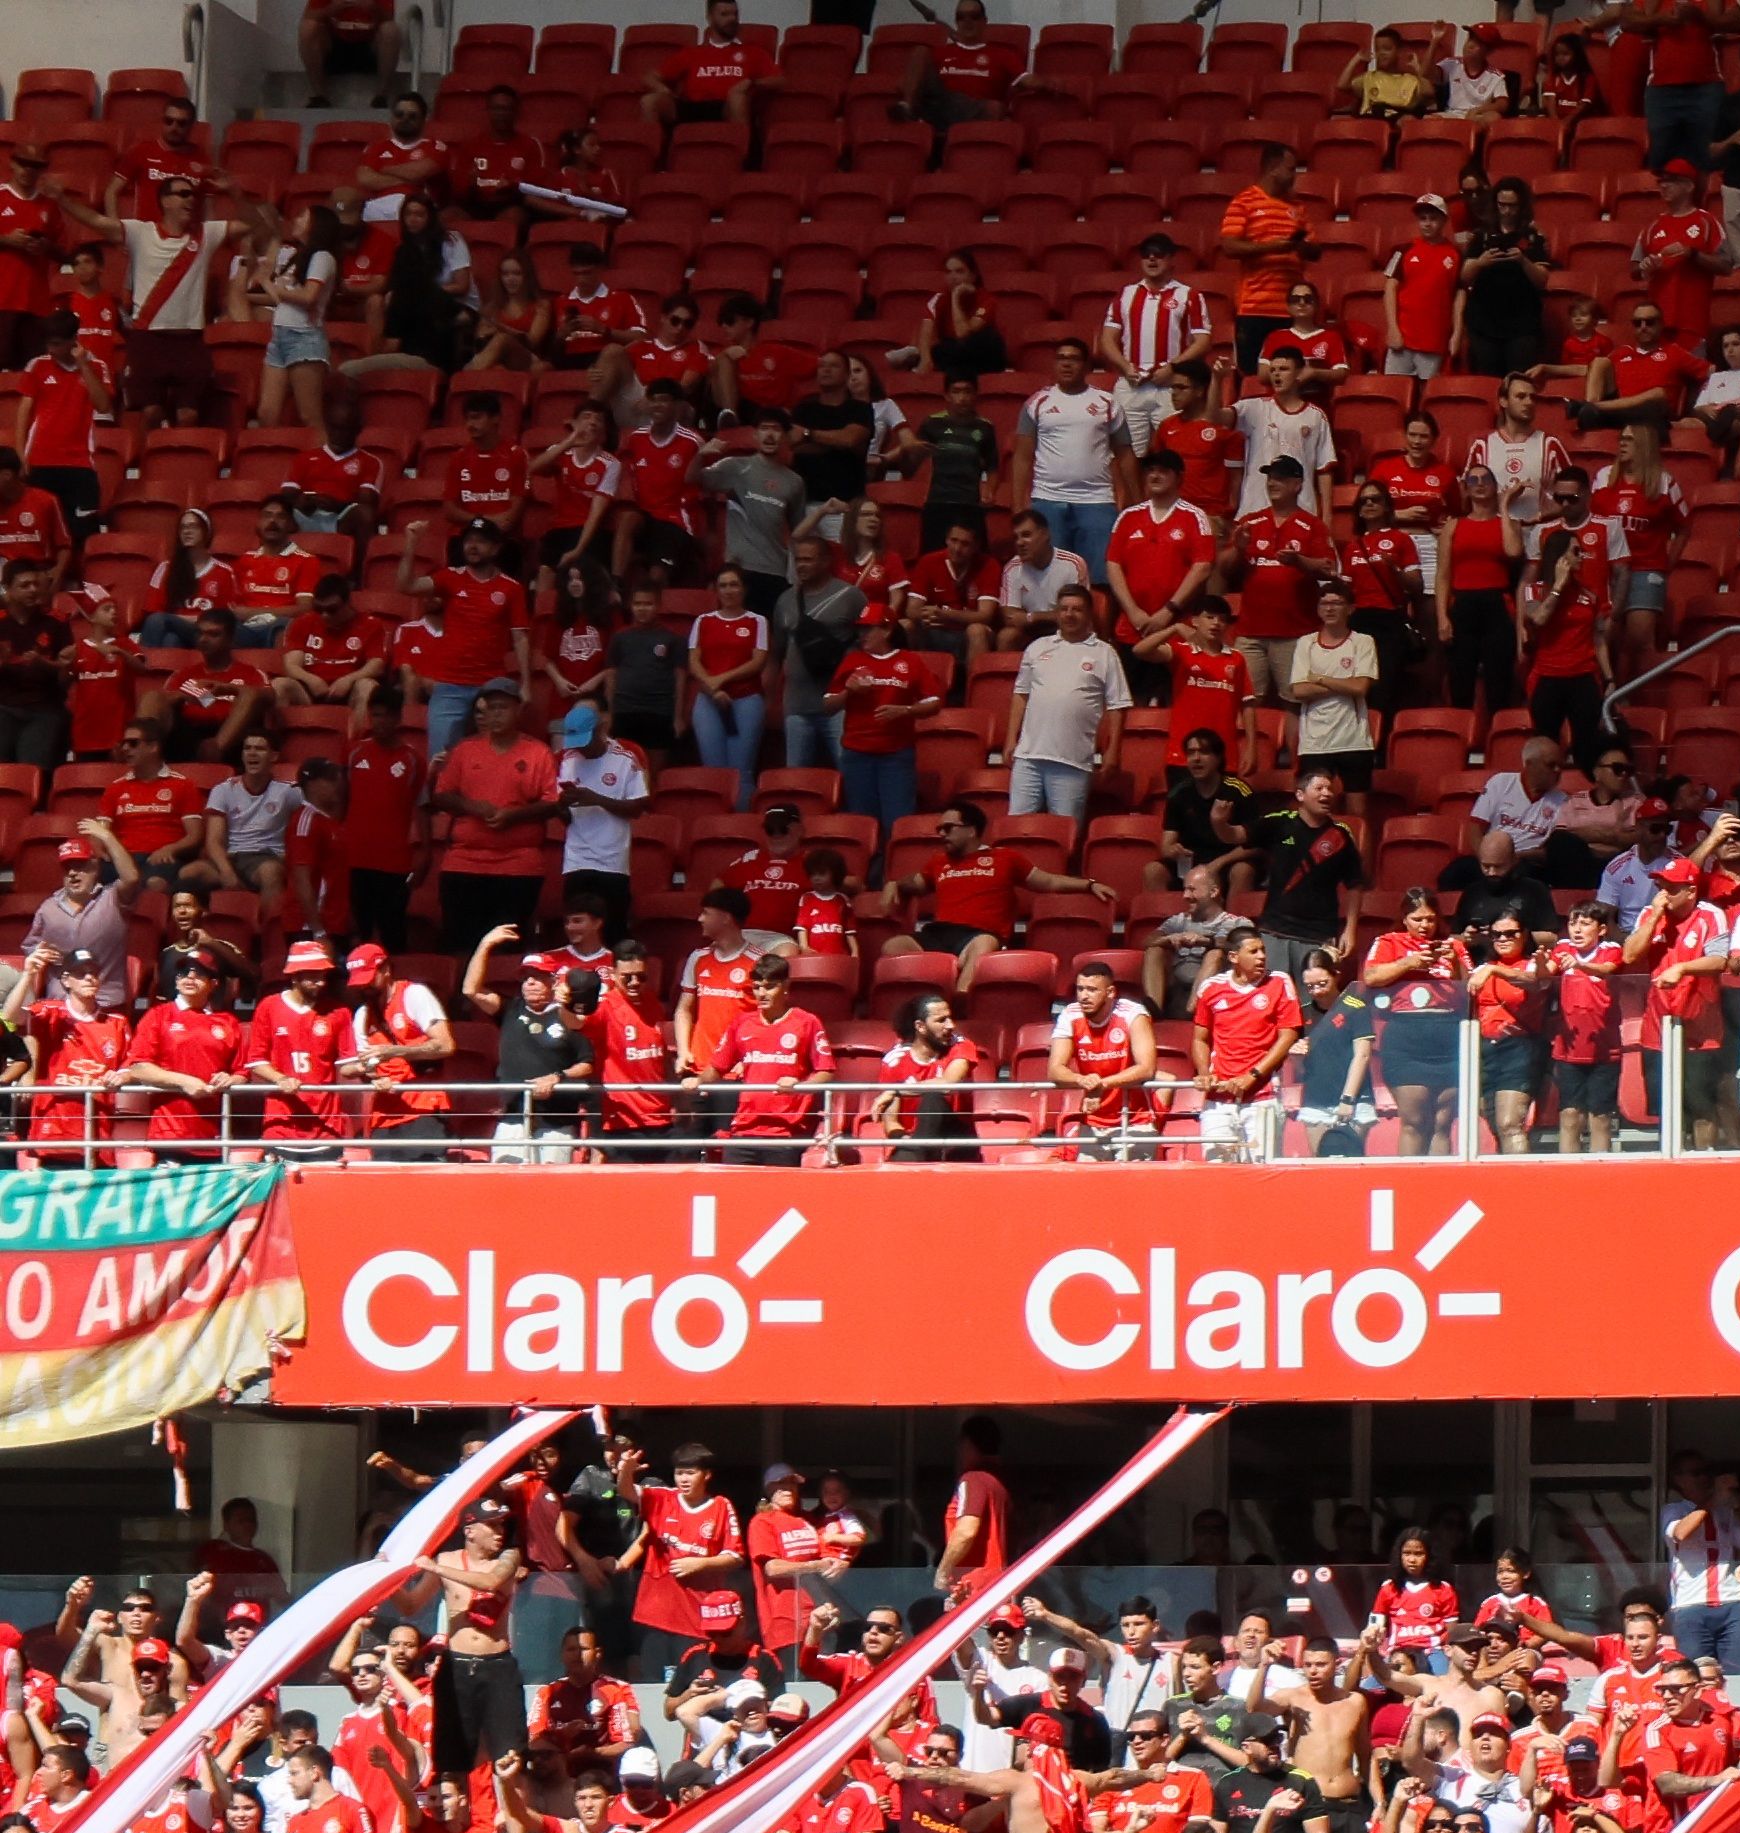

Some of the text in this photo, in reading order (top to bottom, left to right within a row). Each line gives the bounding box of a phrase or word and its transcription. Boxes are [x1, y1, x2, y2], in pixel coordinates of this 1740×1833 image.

[290, 1052, 309, 1074] 15
[343, 1250, 749, 1373] Claro
[1026, 1247, 1428, 1371] Claro
